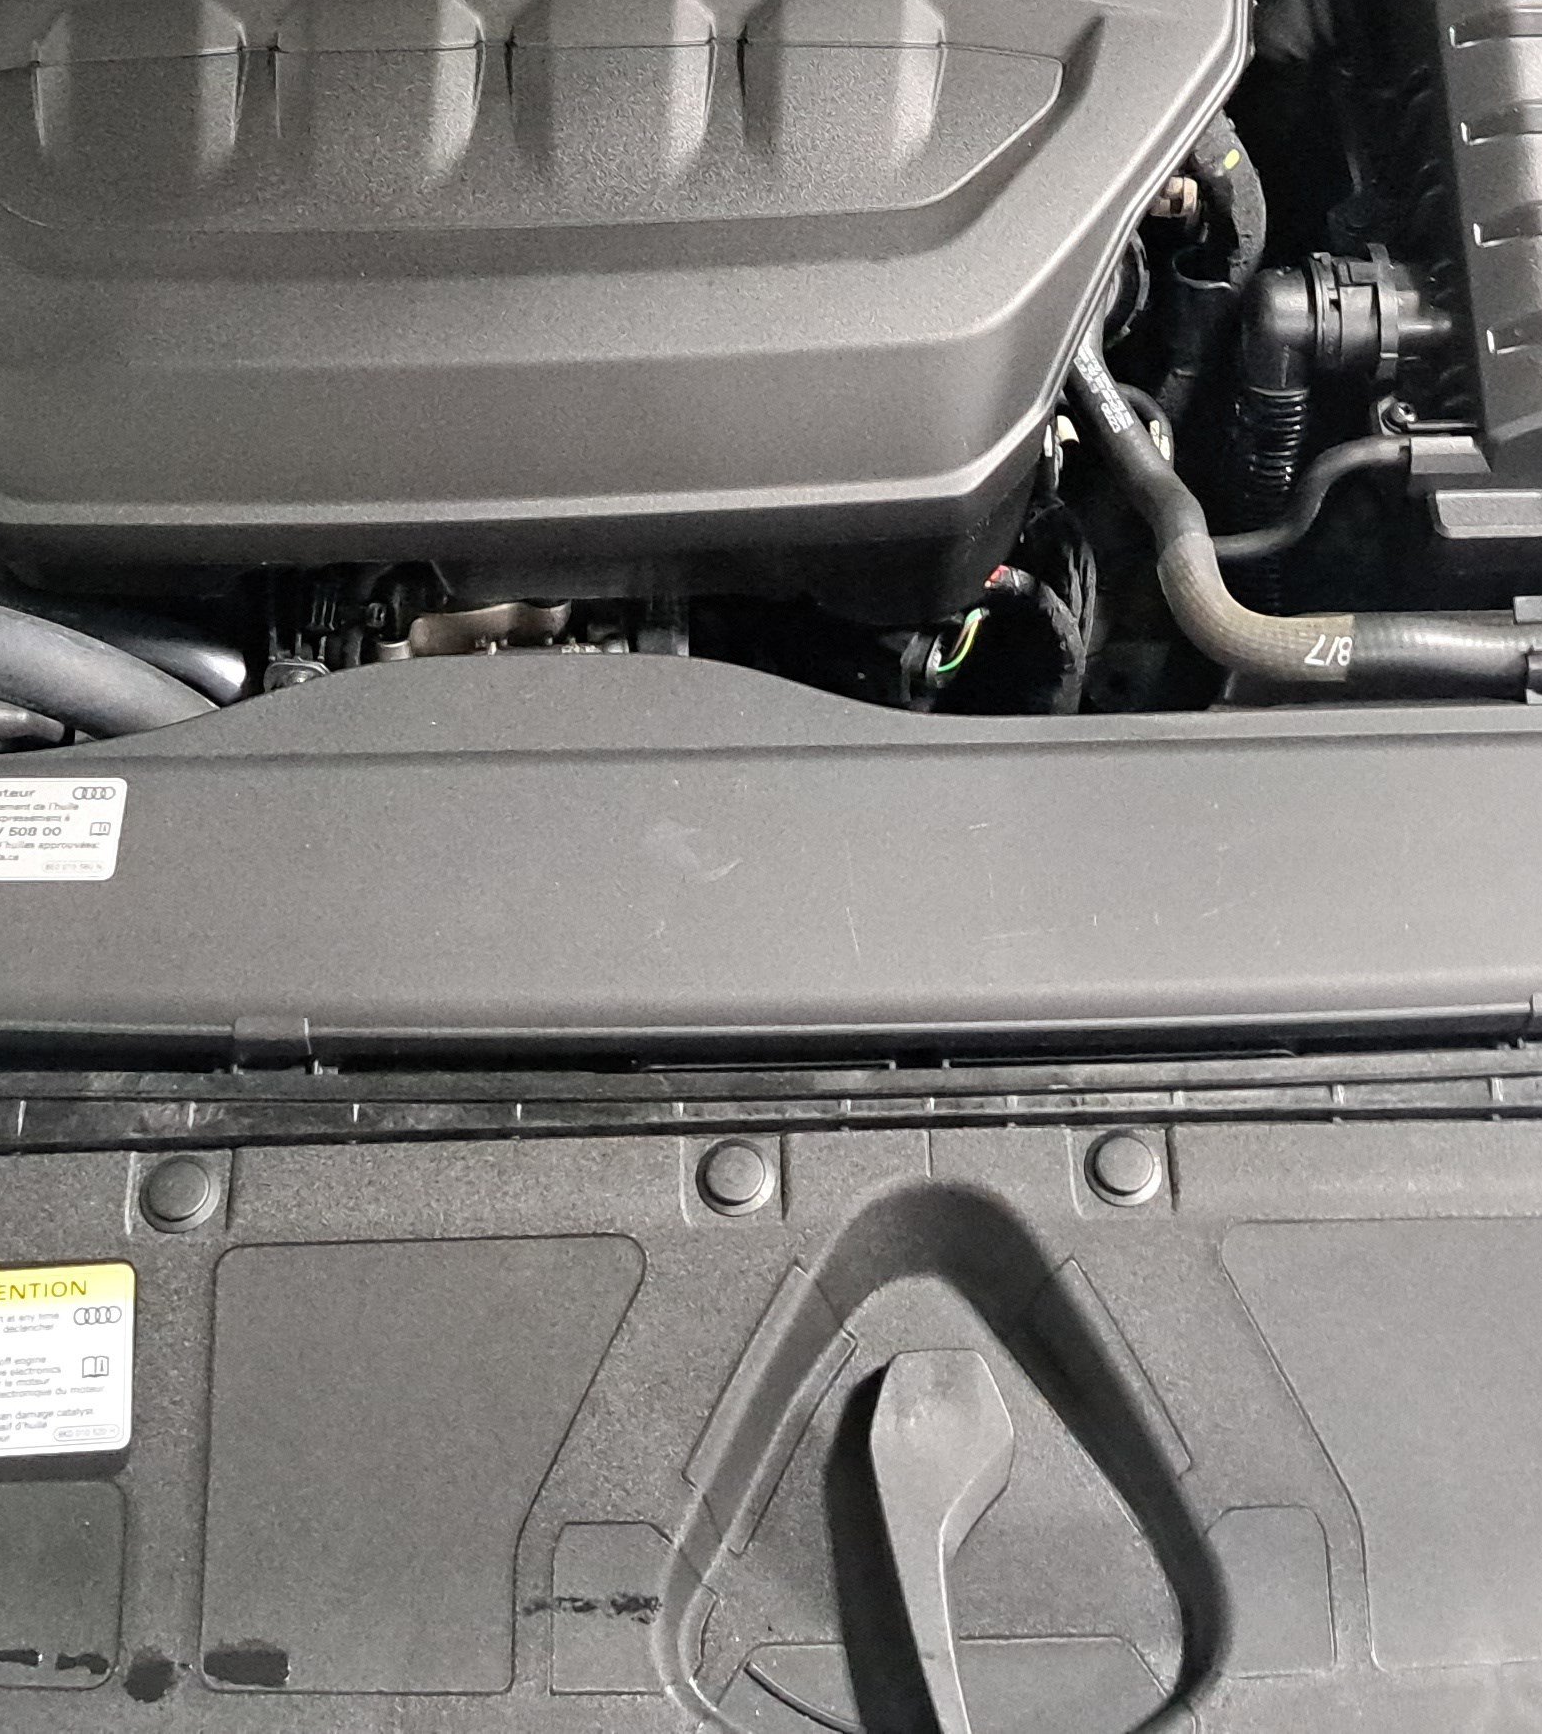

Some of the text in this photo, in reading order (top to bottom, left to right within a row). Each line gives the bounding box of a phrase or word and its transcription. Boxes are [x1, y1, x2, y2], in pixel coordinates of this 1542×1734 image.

[1304, 634, 1353, 666] 8/7
[8, 827, 37, 836] 508
[42, 827, 62, 836] 00
